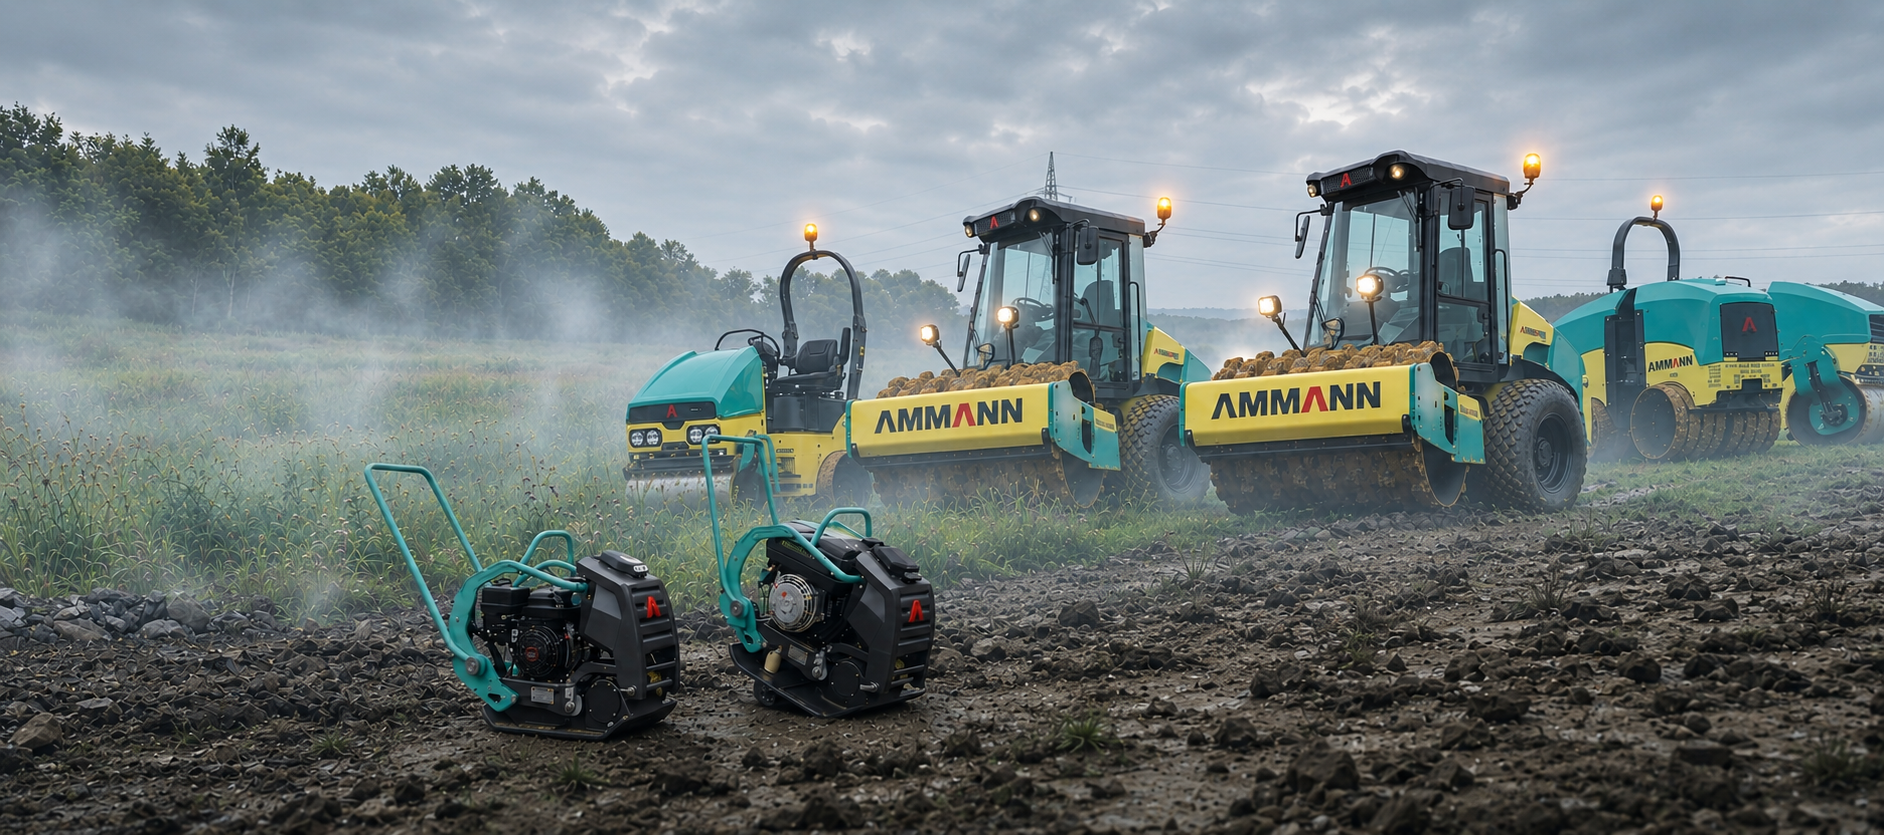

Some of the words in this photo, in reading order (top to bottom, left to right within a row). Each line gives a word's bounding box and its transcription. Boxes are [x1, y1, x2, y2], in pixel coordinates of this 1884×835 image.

[1648, 354, 1693, 373] AMMANN
[874, 398, 1023, 435] AMMANN
[1211, 381, 1381, 420] AMMANN
